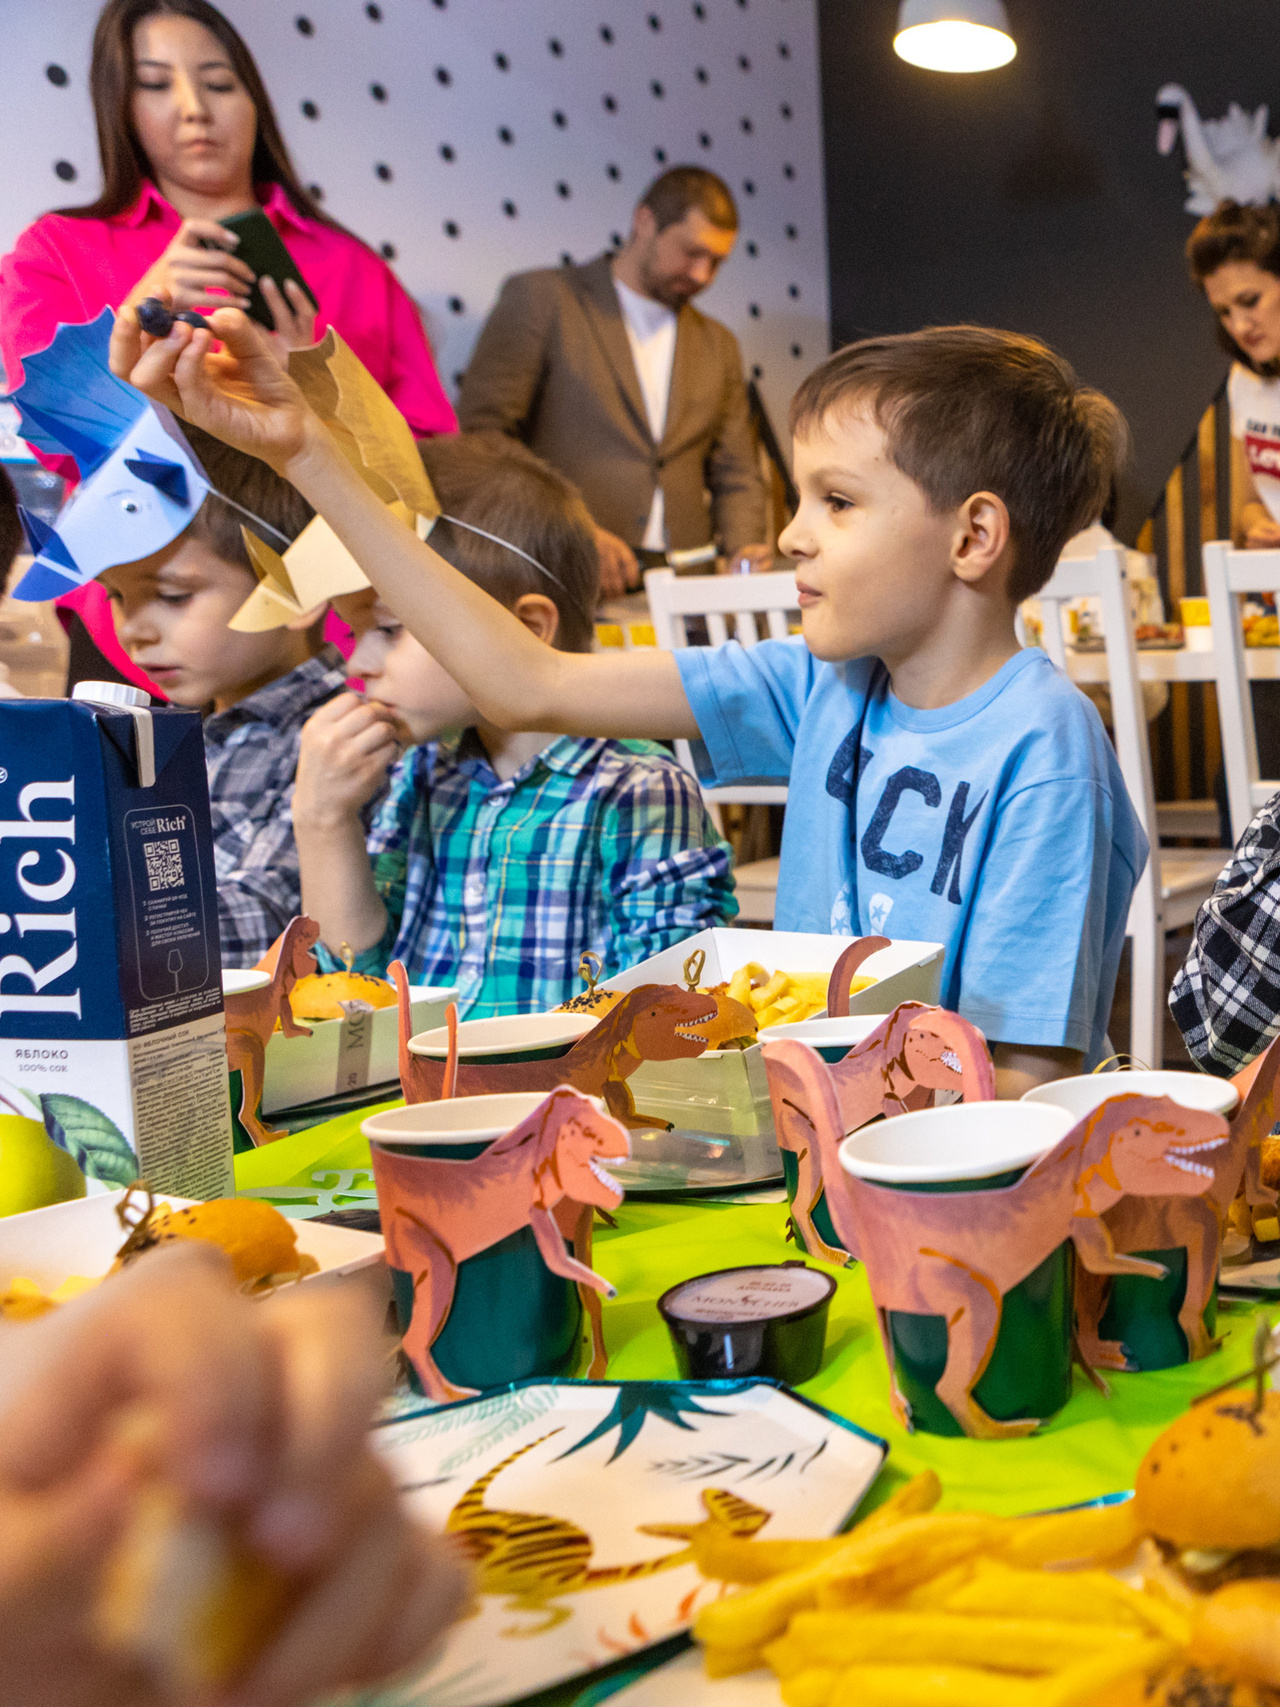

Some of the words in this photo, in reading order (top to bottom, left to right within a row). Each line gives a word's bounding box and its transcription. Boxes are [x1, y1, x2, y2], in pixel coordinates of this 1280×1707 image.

[156, 816, 185, 833] Rich
[0, 774, 82, 1021] Rich
[15, 1048, 69, 1060] ЯБЛОКО
